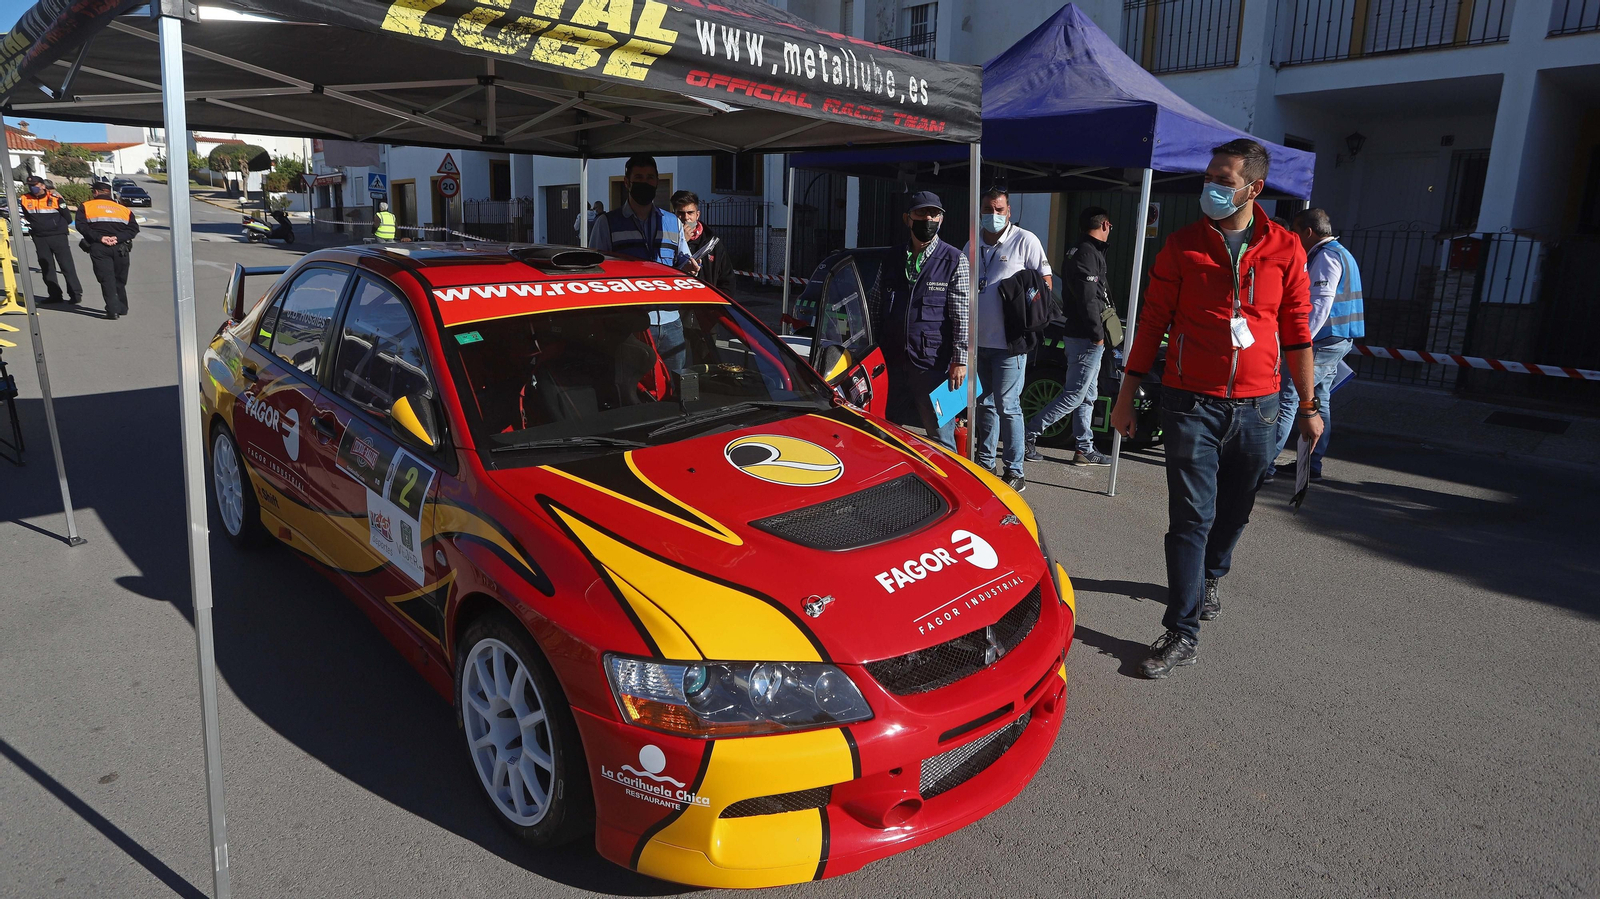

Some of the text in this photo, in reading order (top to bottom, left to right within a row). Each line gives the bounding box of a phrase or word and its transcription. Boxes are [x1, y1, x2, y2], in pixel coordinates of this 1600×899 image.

[685, 69, 813, 109] OFFICIAL
[893, 111, 946, 133] TEAM
[442, 182, 455, 191] 20
[432, 276, 706, 302] www.rosales.es
[245, 395, 280, 432] FAGOR
[247, 447, 305, 493] FAGOR INDUSTRIAL
[399, 466, 419, 509] 2
[874, 547, 958, 594] FAGOR
[918, 576, 1025, 636] FAGOR INDUSTRIAL
[601, 764, 710, 805] La Carihuela Chica
[625, 788, 681, 811] RESTAURANTE
